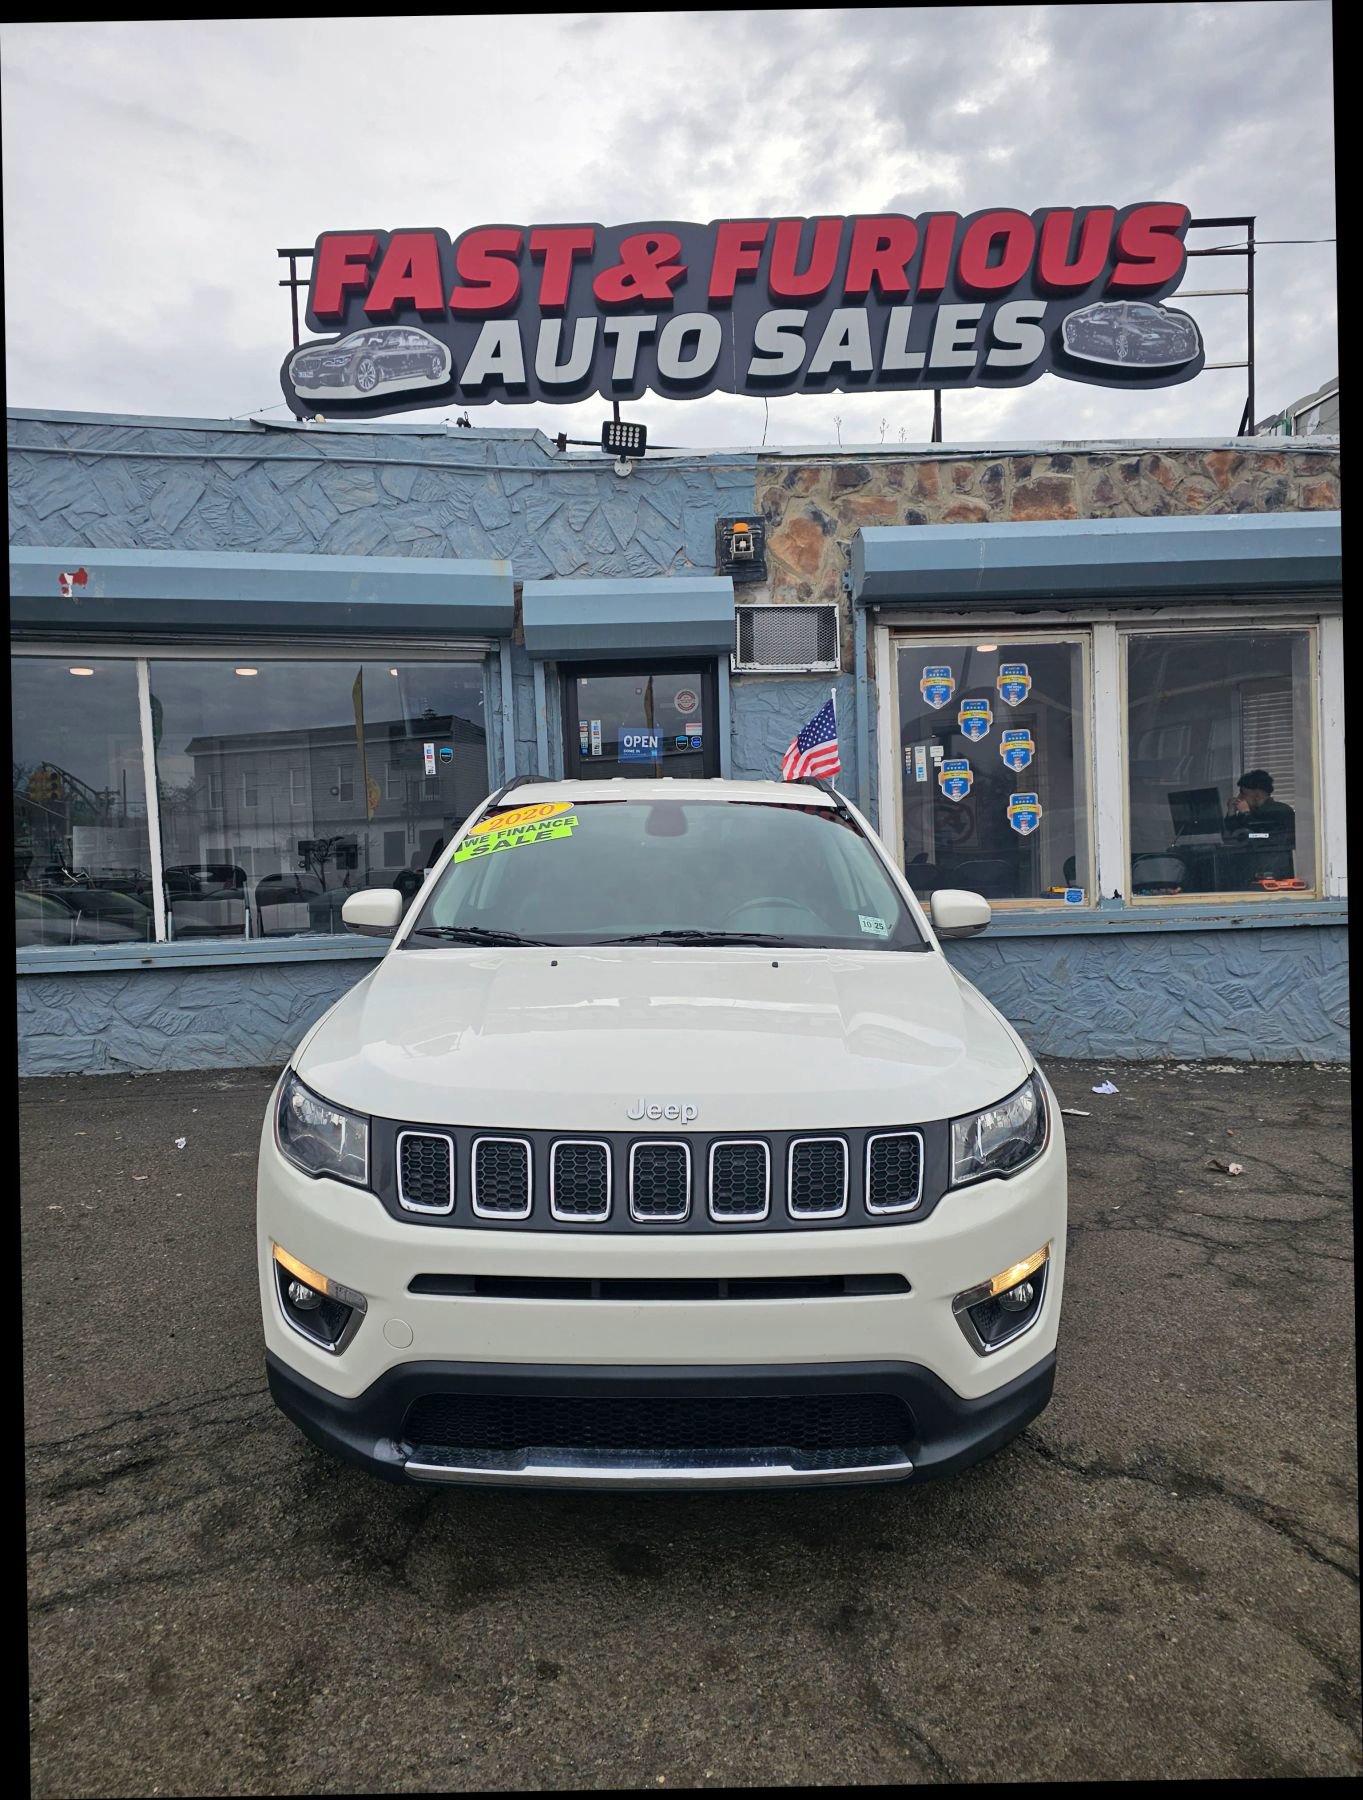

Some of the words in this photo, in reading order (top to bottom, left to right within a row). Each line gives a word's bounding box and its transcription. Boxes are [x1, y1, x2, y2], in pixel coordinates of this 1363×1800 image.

[312, 227, 596, 318] FAST
[593, 232, 688, 305] &
[707, 204, 1190, 301] FURIOUS
[460, 311, 722, 387] AUTO
[747, 300, 1048, 377] SALES
[623, 735, 658, 748] OPEN
[489, 804, 555, 831] 2020
[464, 835, 489, 848] WE
[497, 817, 575, 839] FINANCE
[470, 829, 554, 857] SALE
[862, 920, 872, 928] 10
[874, 922, 884, 930] 25
[626, 1096, 698, 1126] Jeep
